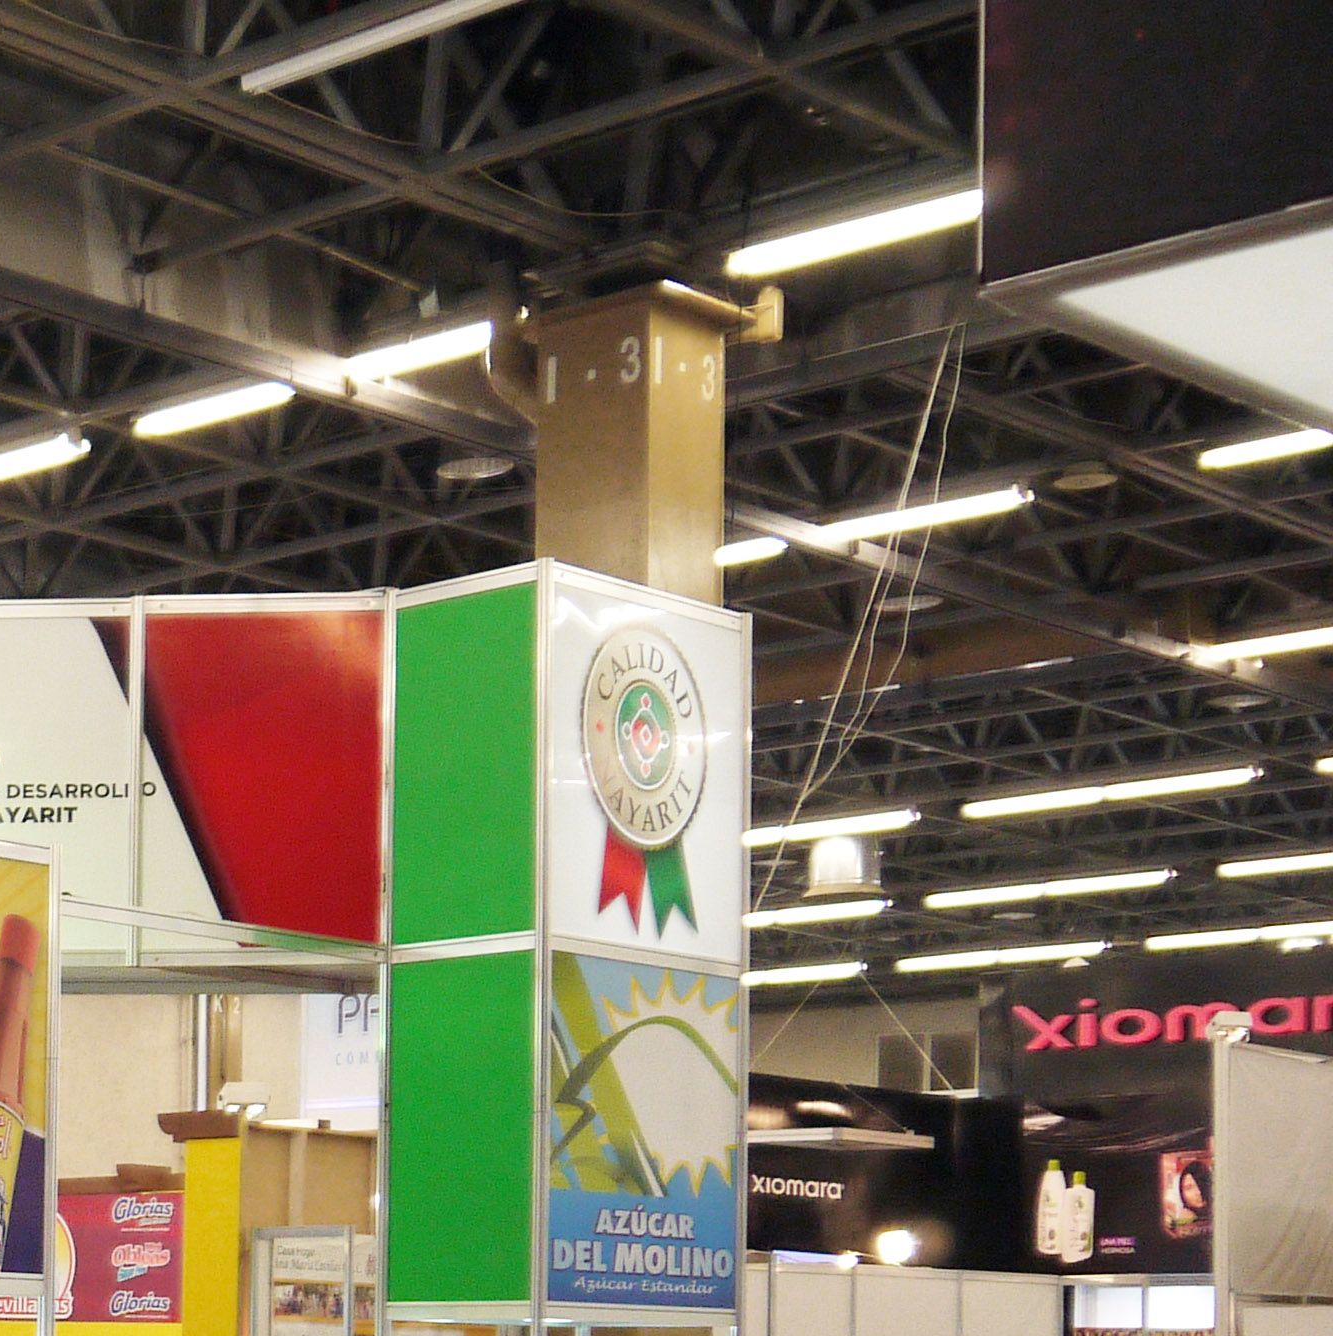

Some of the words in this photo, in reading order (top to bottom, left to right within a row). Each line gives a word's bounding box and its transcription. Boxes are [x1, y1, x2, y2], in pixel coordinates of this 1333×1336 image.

[597, 643, 693, 720] CALIDAD
[751, 1173, 844, 1201] xiomara
[113, 1197, 173, 1222] Glorias
[595, 1204, 696, 1240] AZÚCAR
[552, 1238, 608, 1273] DEL
[614, 1242, 734, 1279] MOLINO
[574, 1275, 635, 1293] Azúcar
[111, 1291, 170, 1315] Glorias
